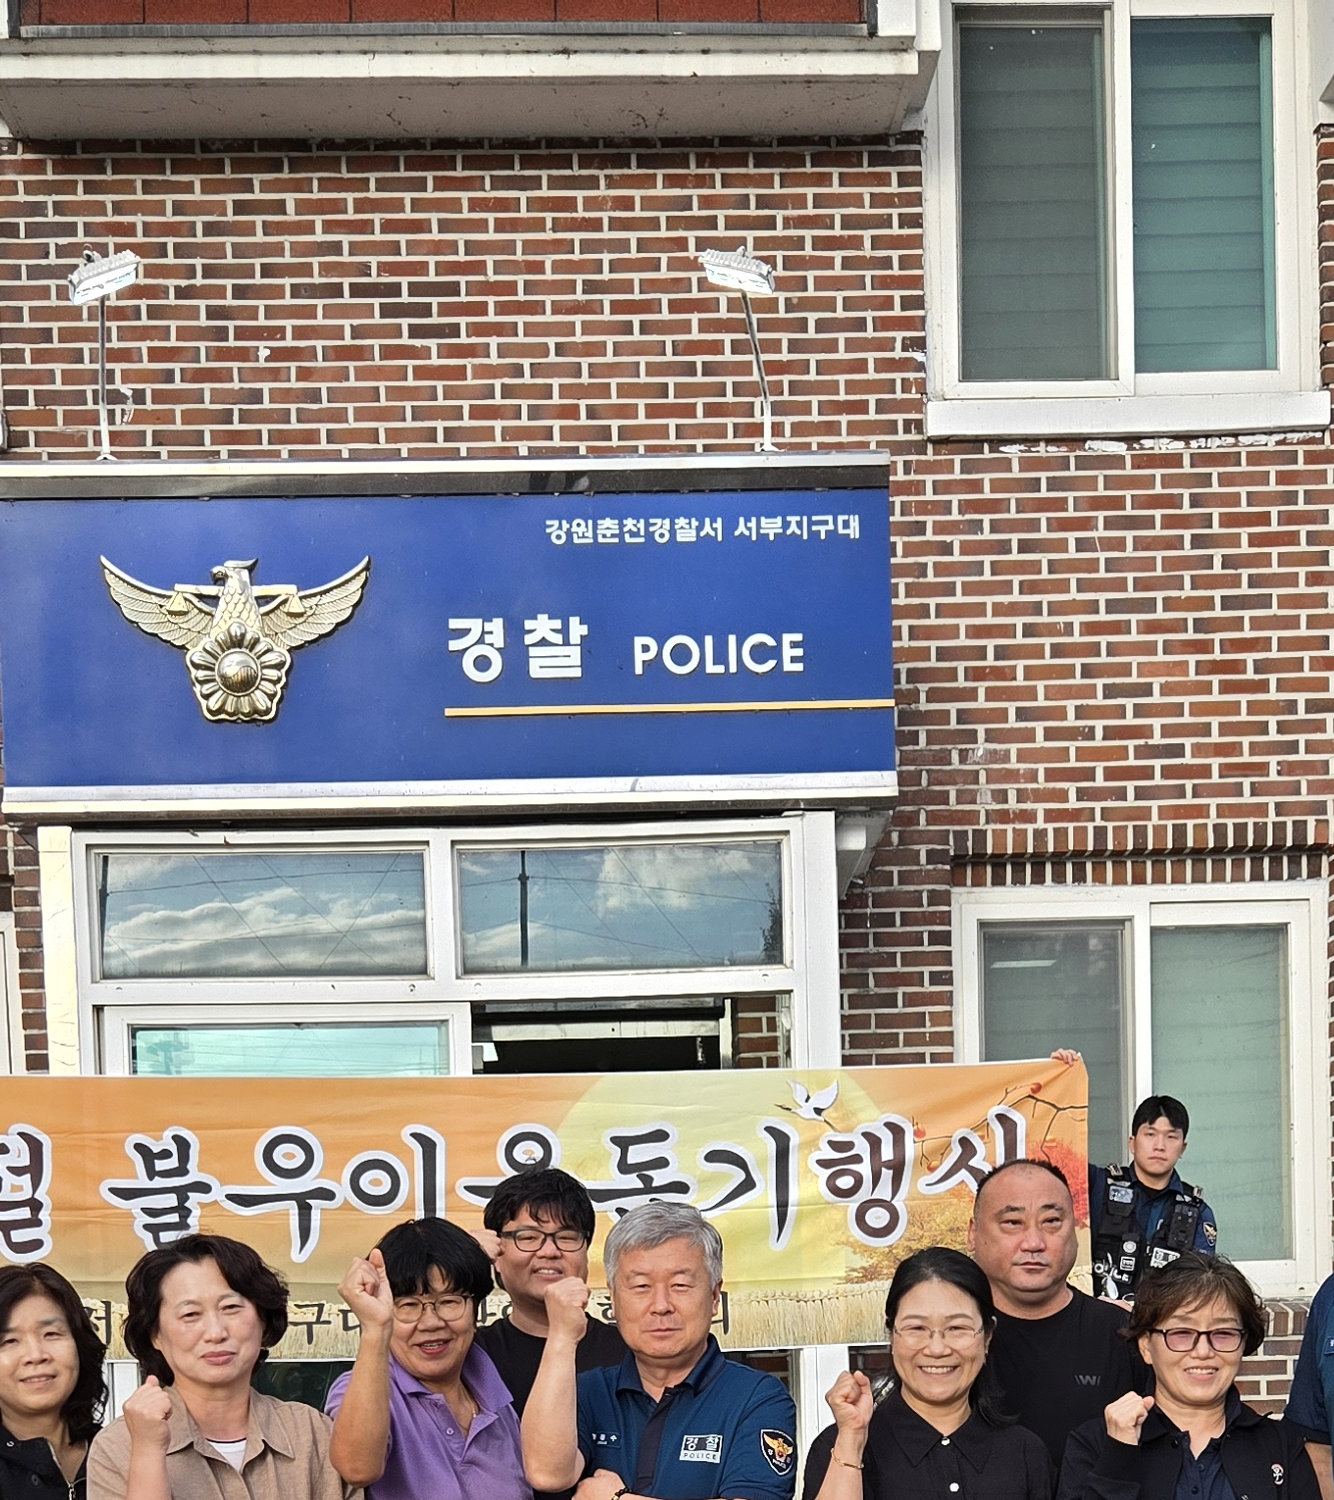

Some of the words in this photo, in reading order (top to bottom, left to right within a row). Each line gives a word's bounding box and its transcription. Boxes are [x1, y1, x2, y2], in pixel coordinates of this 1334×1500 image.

[545, 517, 722, 545] 강원춘천경찰서
[735, 514, 860, 542] 서부지구대
[447, 615, 588, 682] 경찰
[634, 633, 804, 675] POLICE
[686, 1437, 720, 1451] 경찰
[683, 1452, 717, 1461] POLICE
